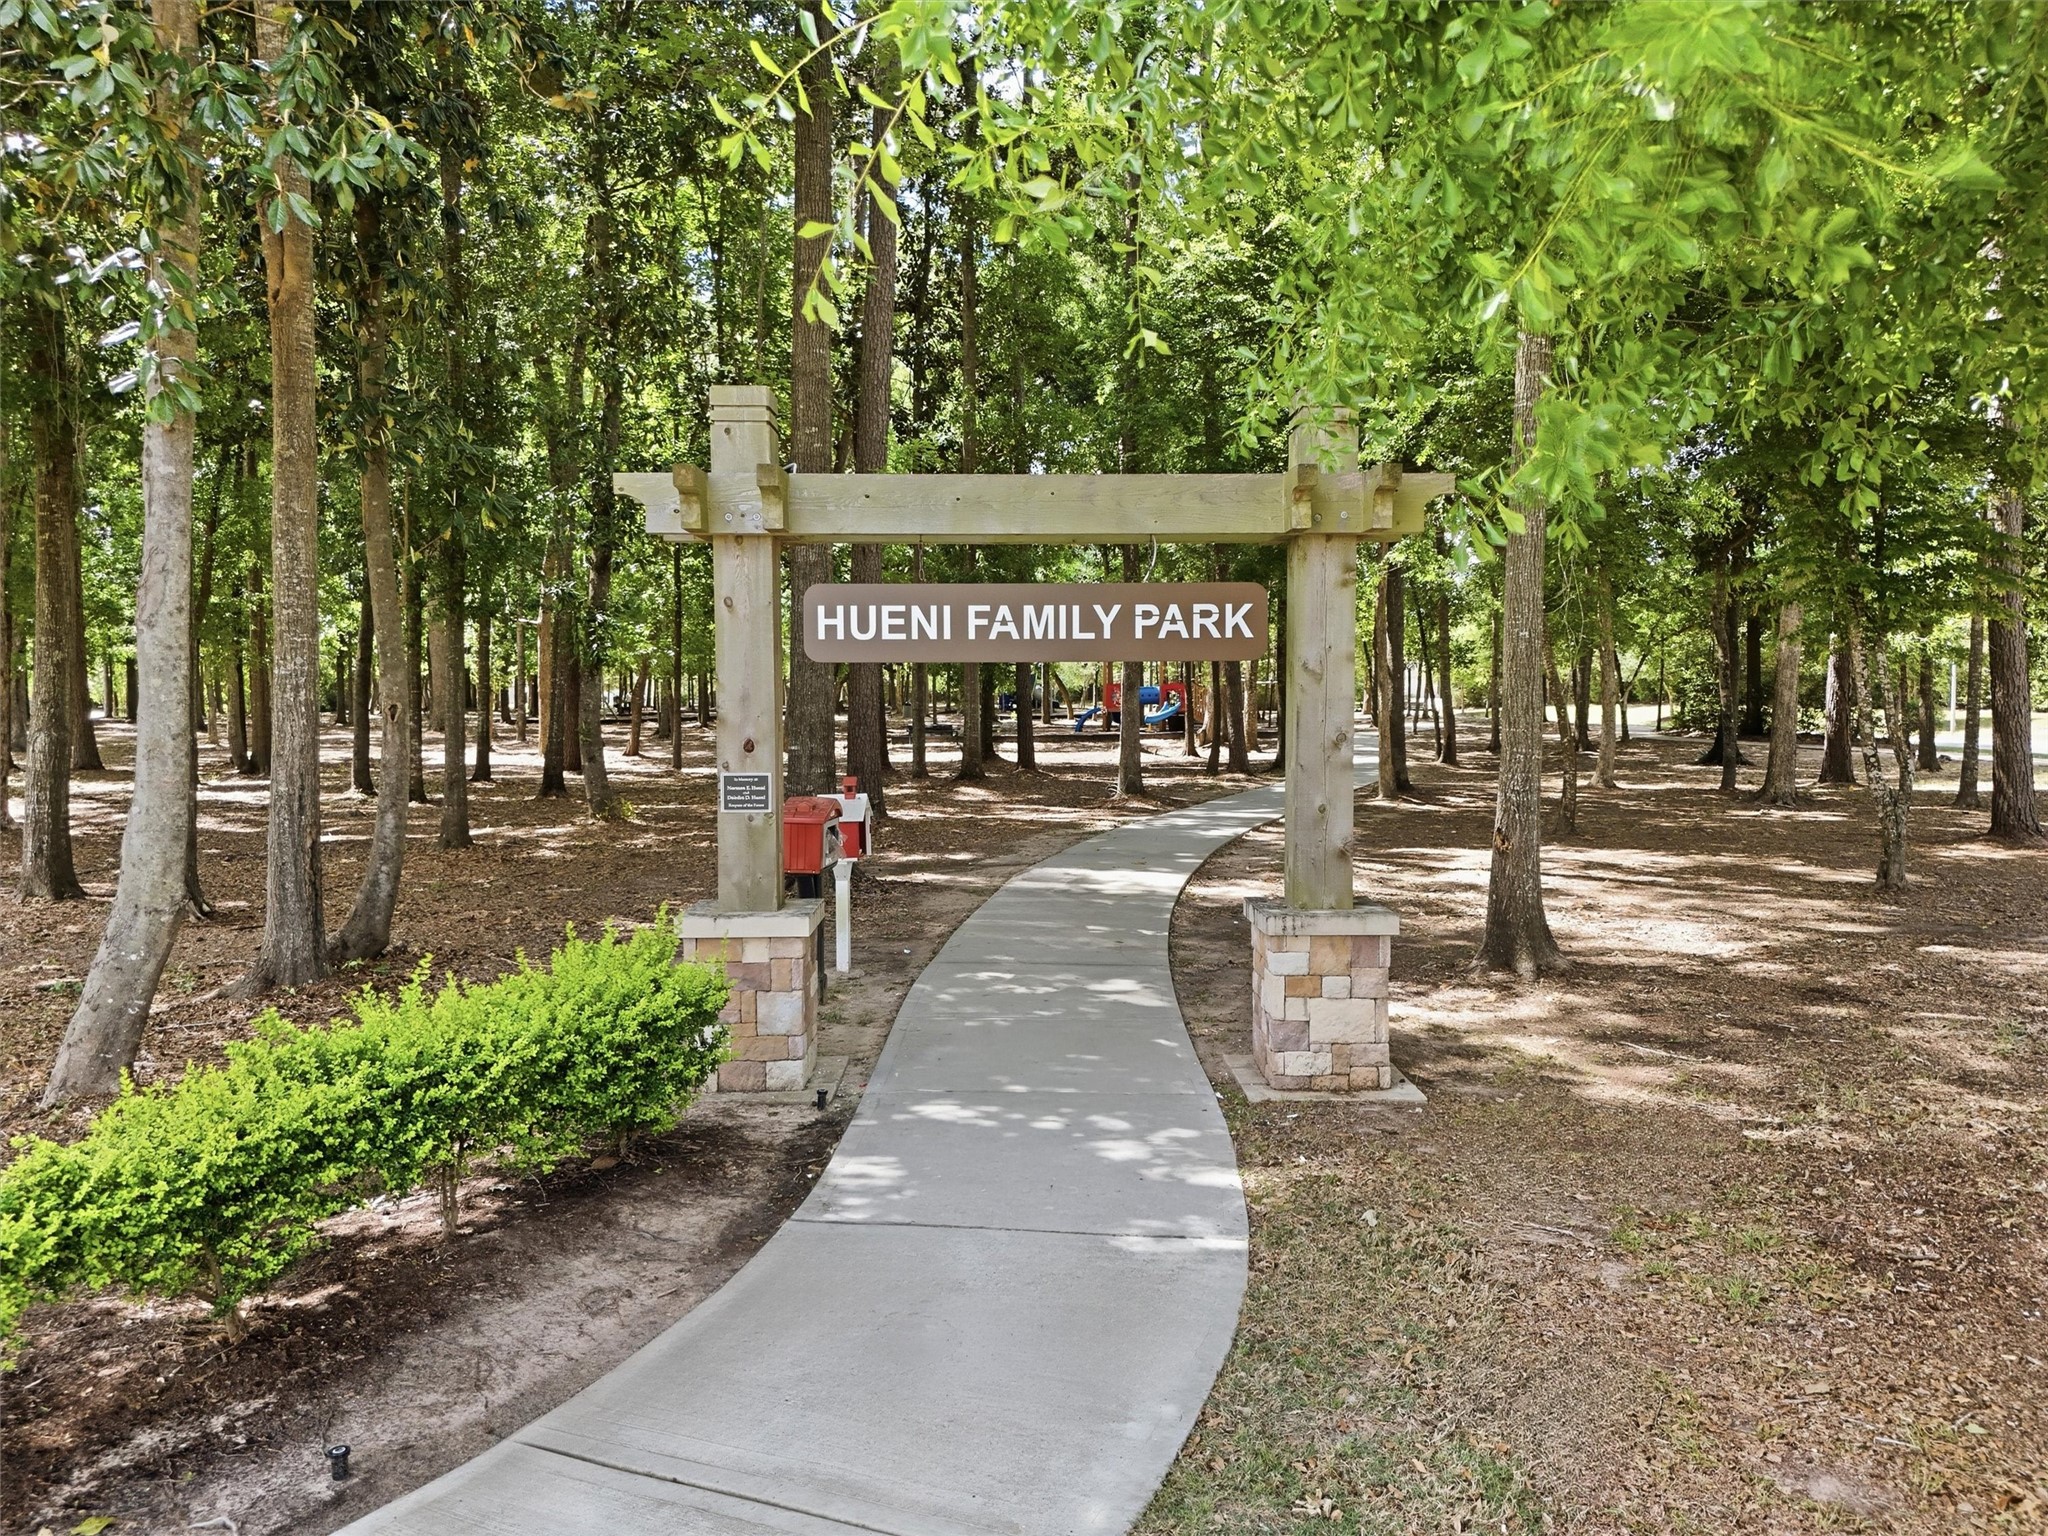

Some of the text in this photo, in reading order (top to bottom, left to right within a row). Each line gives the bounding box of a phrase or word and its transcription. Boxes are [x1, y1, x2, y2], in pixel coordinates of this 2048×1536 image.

[816, 602, 1254, 641] HUENI FAMILY PARK
